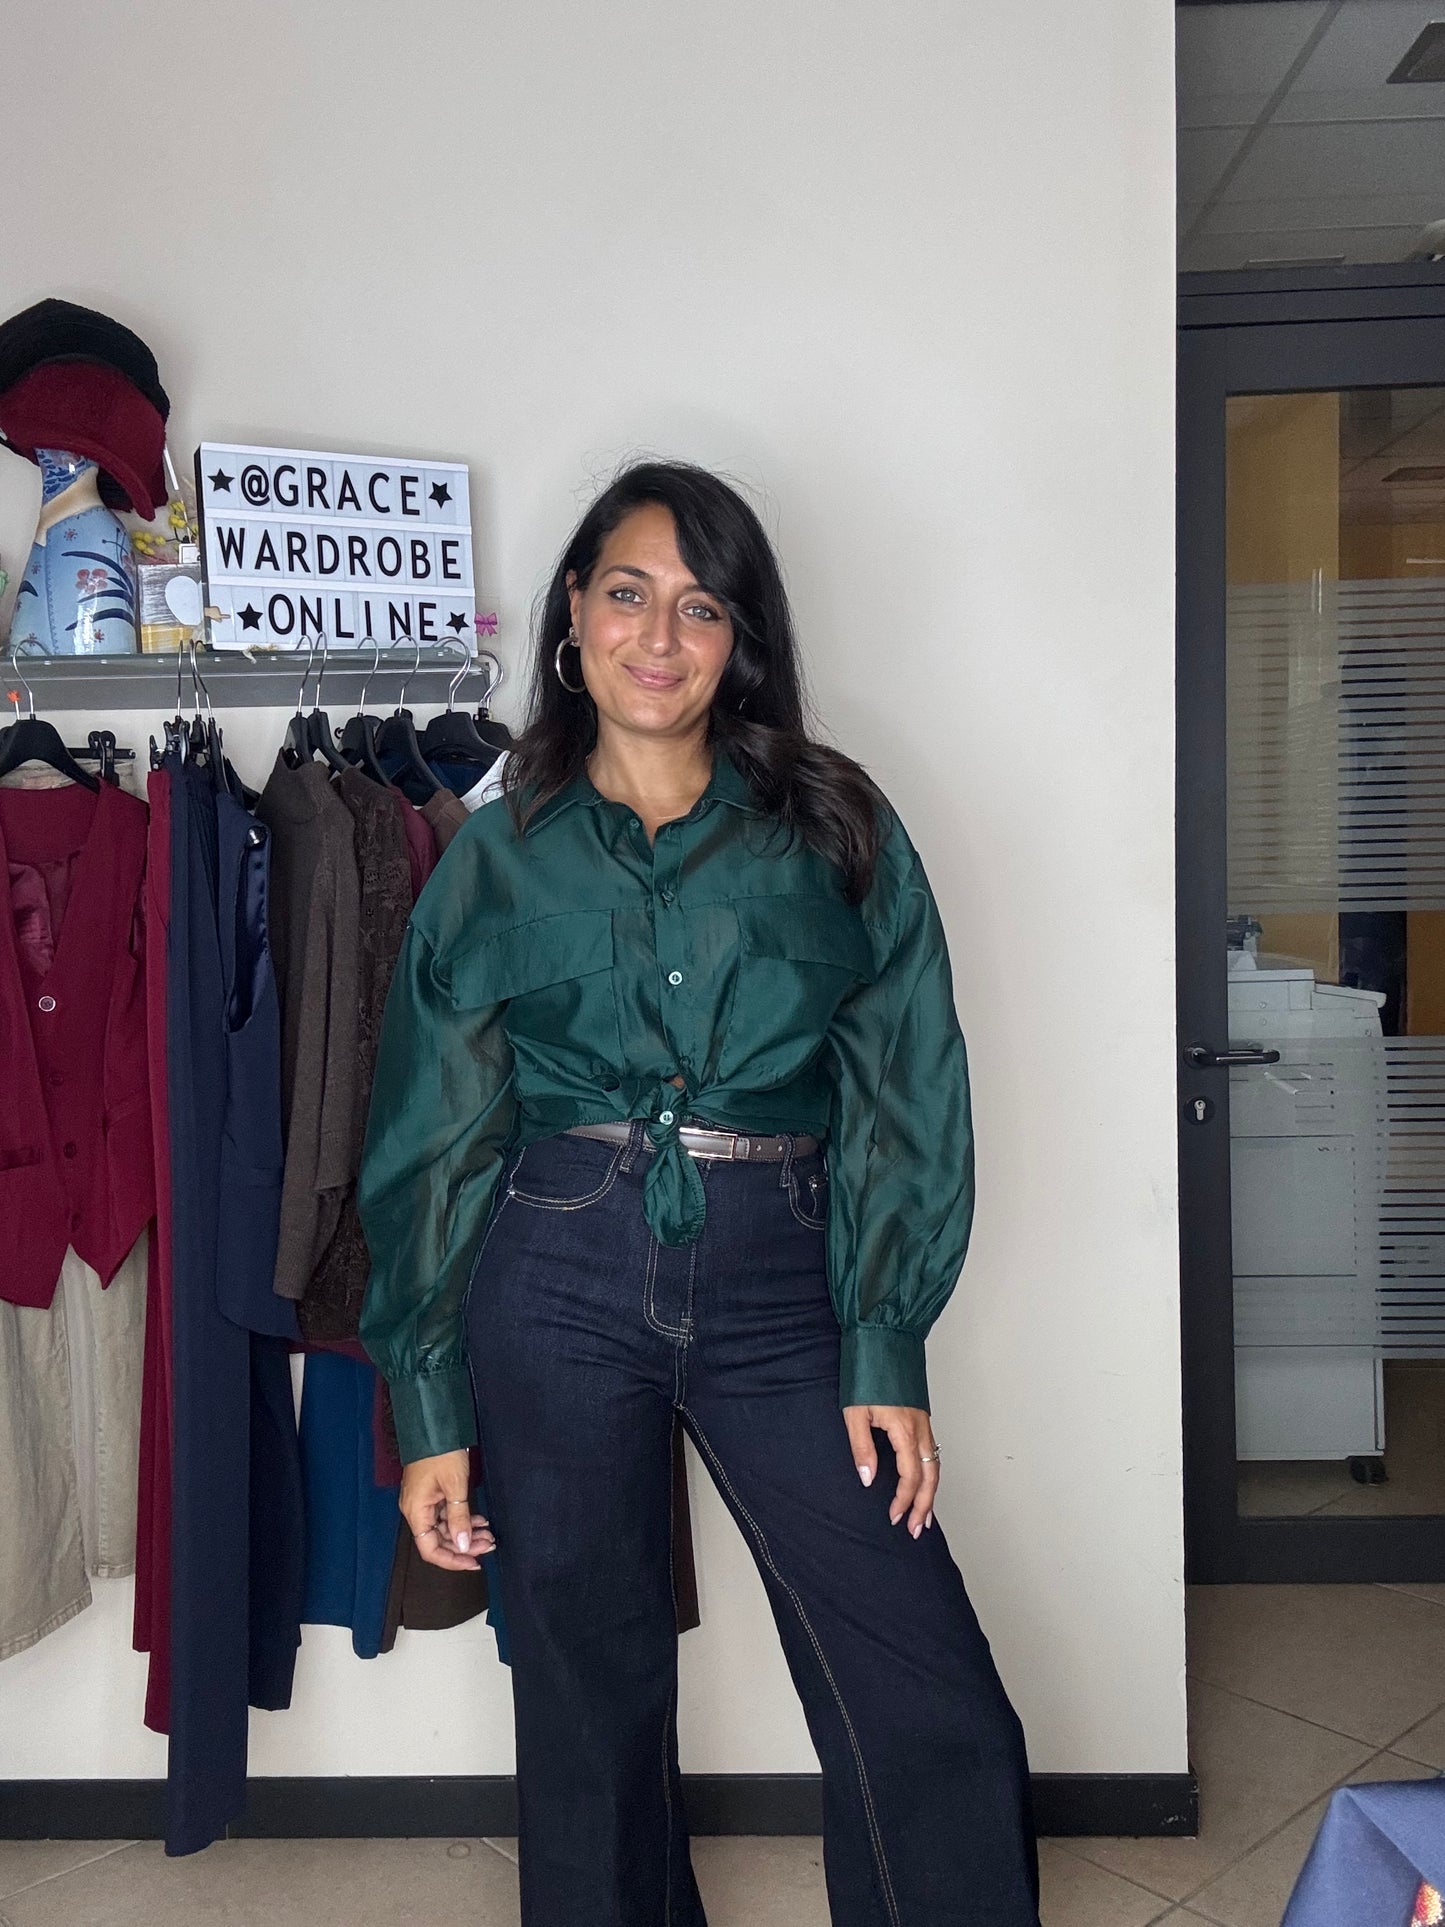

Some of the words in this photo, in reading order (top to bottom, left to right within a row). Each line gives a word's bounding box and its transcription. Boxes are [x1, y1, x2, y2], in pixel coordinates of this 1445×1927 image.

[240, 464, 421, 516] @GRACE
[216, 526, 462, 580] WARDROBE
[268, 593, 438, 642] ONLINE
